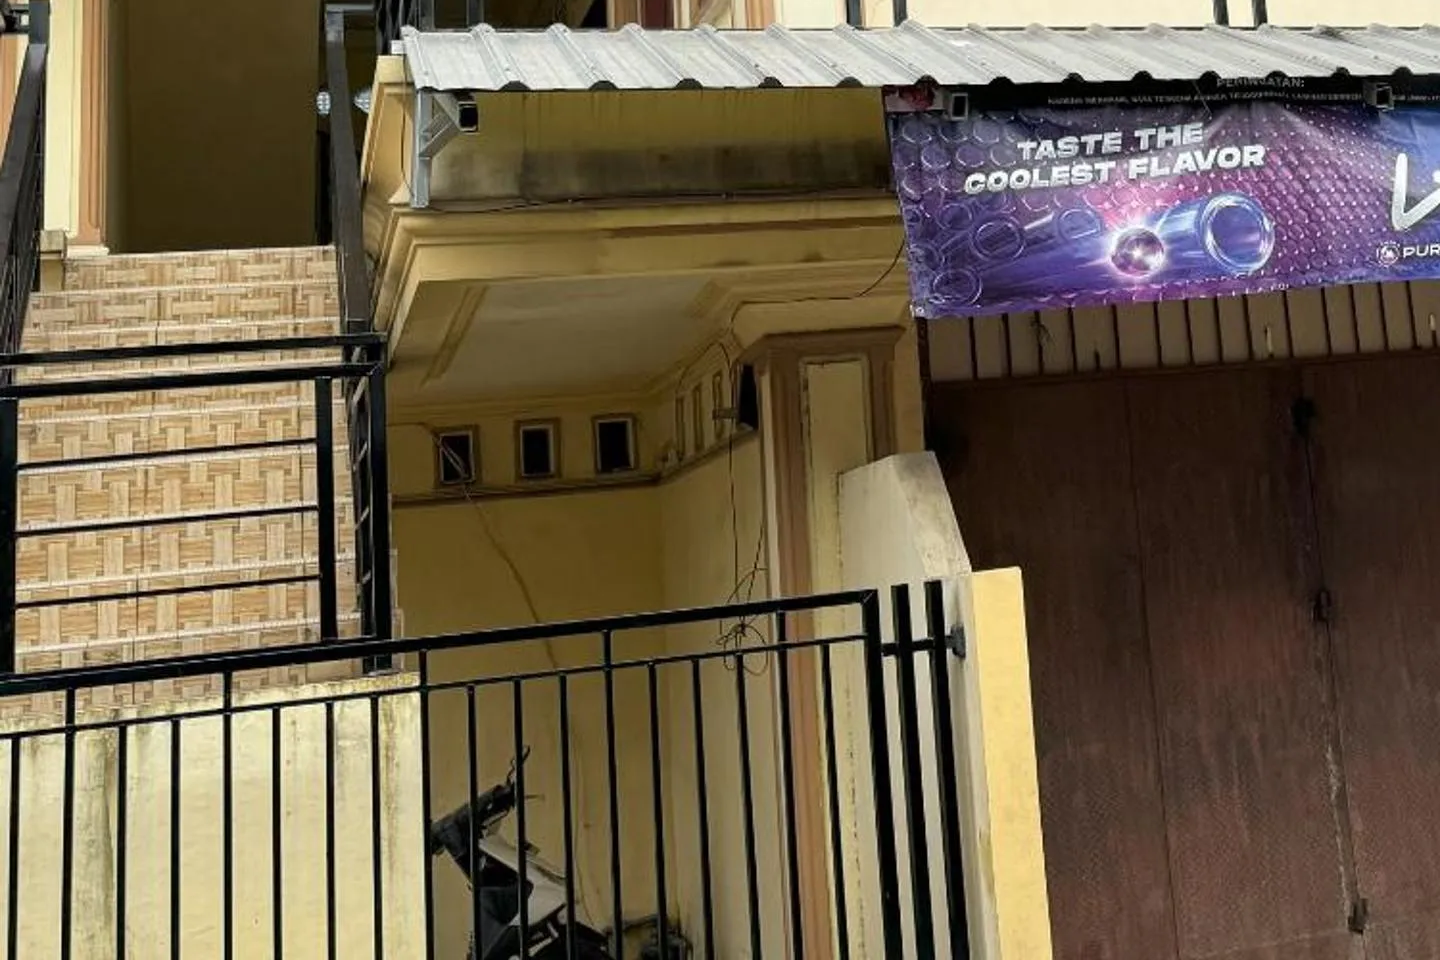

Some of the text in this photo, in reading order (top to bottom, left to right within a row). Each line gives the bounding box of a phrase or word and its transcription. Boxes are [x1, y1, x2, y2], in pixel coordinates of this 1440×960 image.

[1017, 122, 1204, 161] TASTE THE
[964, 144, 1266, 195] COOLEST FLAVOR
